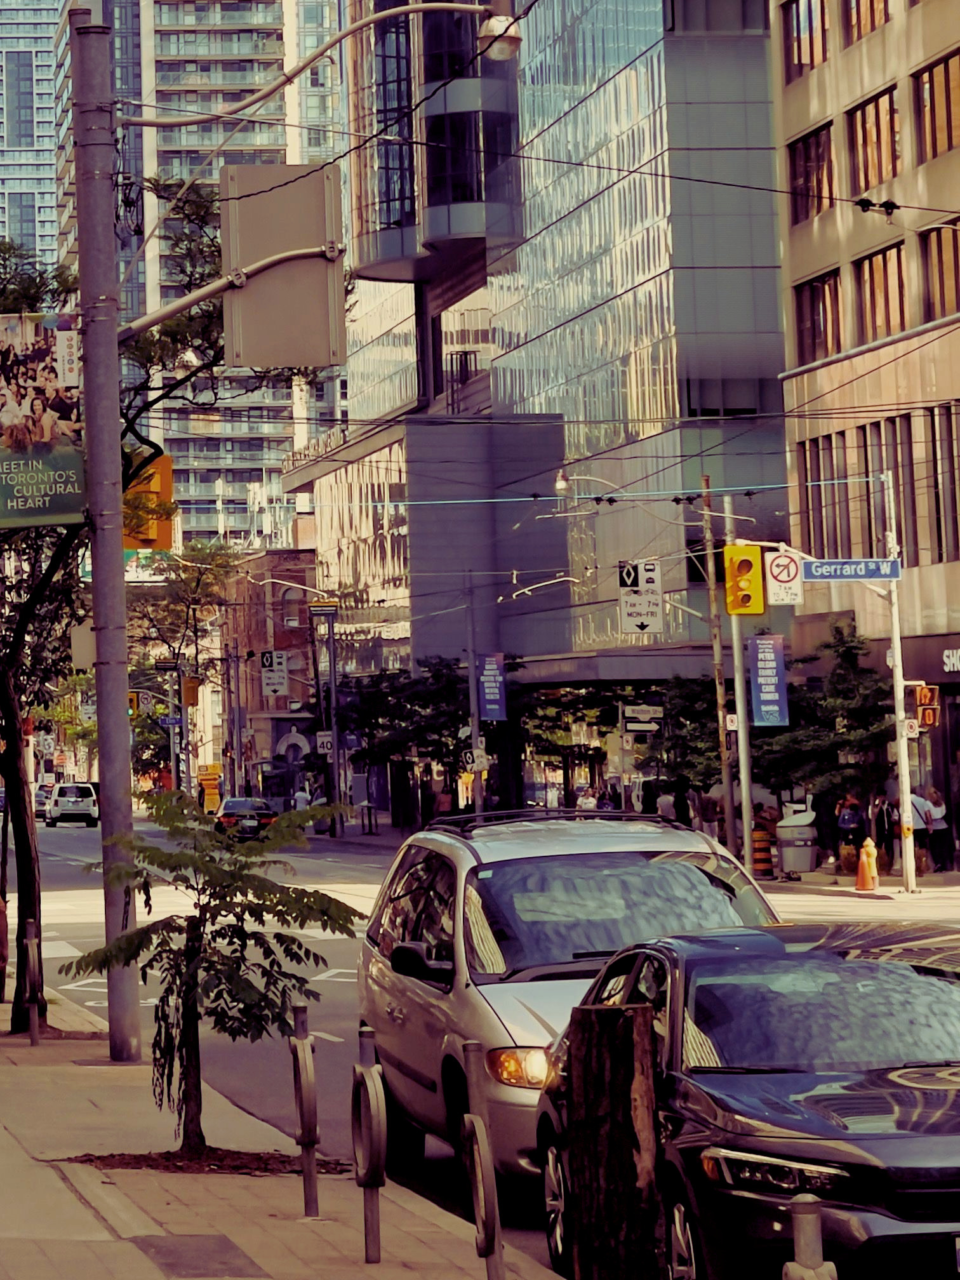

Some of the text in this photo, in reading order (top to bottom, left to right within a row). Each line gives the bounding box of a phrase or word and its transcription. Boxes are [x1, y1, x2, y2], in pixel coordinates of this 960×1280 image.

[29, 459, 42, 471] IN
[0, 470, 77, 485] TORONTO'S
[13, 483, 82, 497] CULTURAL
[7, 496, 51, 510] HEART
[811, 562, 891, 576] Gerrard St W
[627, 611, 658, 619] MON-FRI
[319, 741, 333, 750] 40
